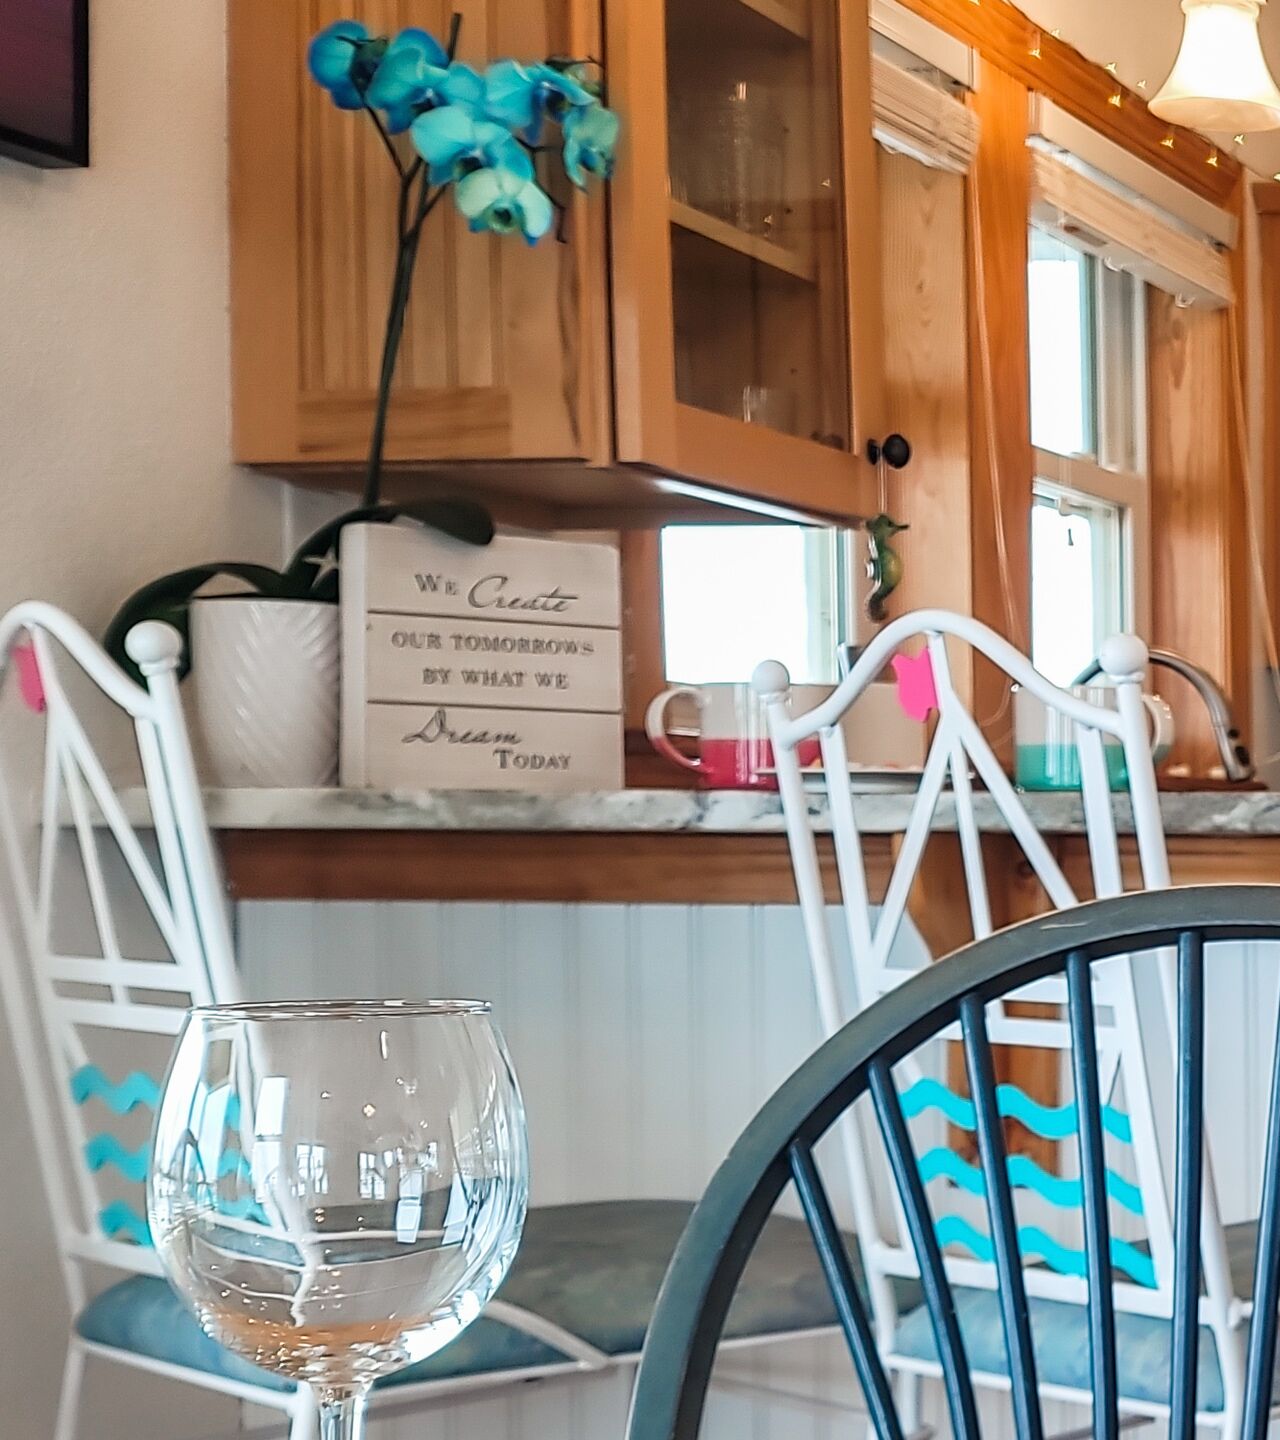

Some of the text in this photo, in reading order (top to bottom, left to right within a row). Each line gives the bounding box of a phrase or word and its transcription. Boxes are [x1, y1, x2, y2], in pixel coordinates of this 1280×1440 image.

[467, 574, 579, 613] Create
[391, 631, 595, 656] OUR TOMORROWS
[422, 668, 570, 690] BY WHAT WE
[402, 706, 523, 745] Dream
